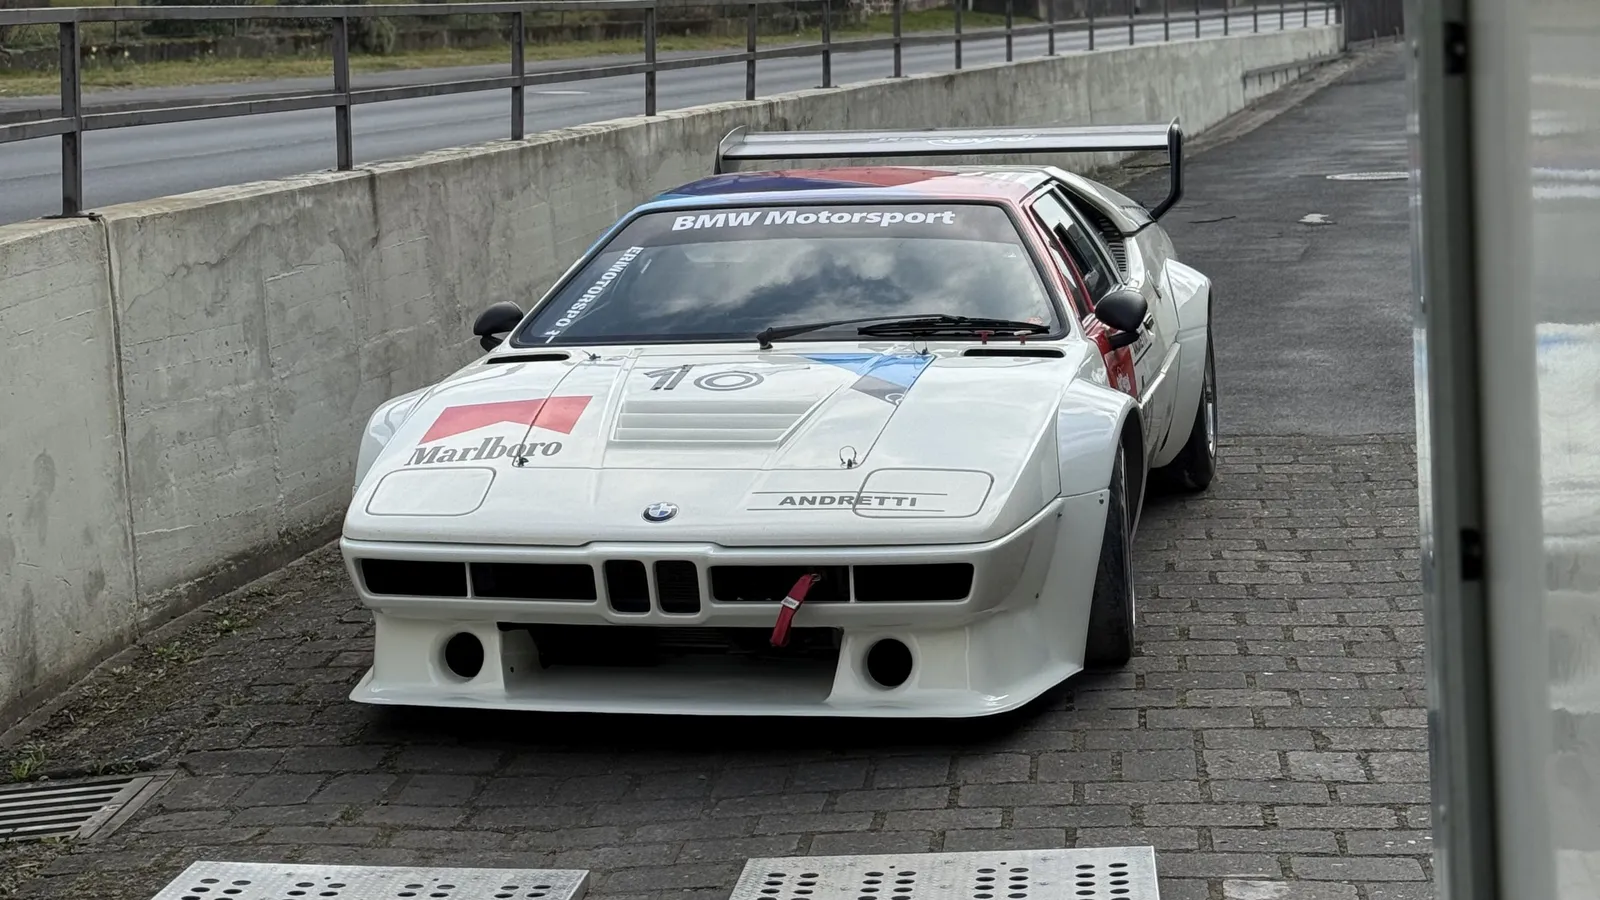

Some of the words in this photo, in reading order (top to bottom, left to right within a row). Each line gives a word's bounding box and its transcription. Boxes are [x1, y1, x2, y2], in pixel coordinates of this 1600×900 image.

[672, 211, 761, 231] BMW
[764, 210, 956, 227] Motorsport
[643, 364, 764, 391] 10
[403, 436, 563, 466] Marlboro
[779, 495, 917, 507] ANDRETTI
